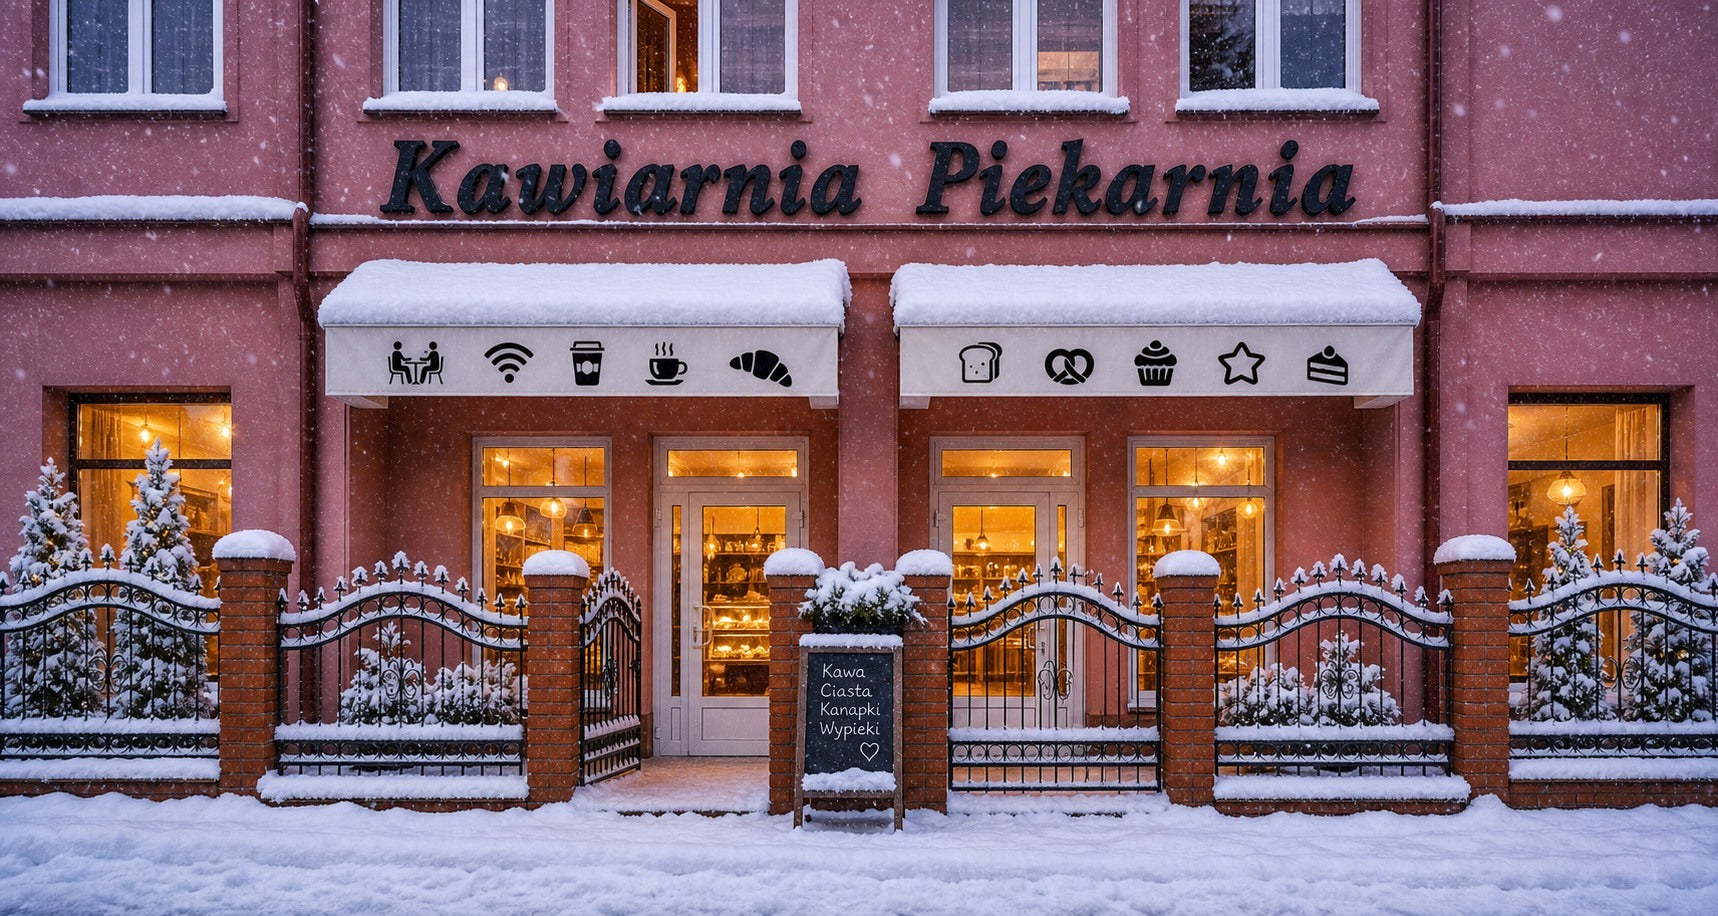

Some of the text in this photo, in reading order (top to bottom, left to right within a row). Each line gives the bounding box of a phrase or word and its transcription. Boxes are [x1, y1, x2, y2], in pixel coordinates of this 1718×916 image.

[380, 138, 1356, 216] Kawiarnia Piekarnia
[822, 663, 866, 678] Kawa
[820, 683, 873, 698] Ciasta
[820, 702, 881, 720] Kanapki
[819, 721, 881, 741] Wypieki
